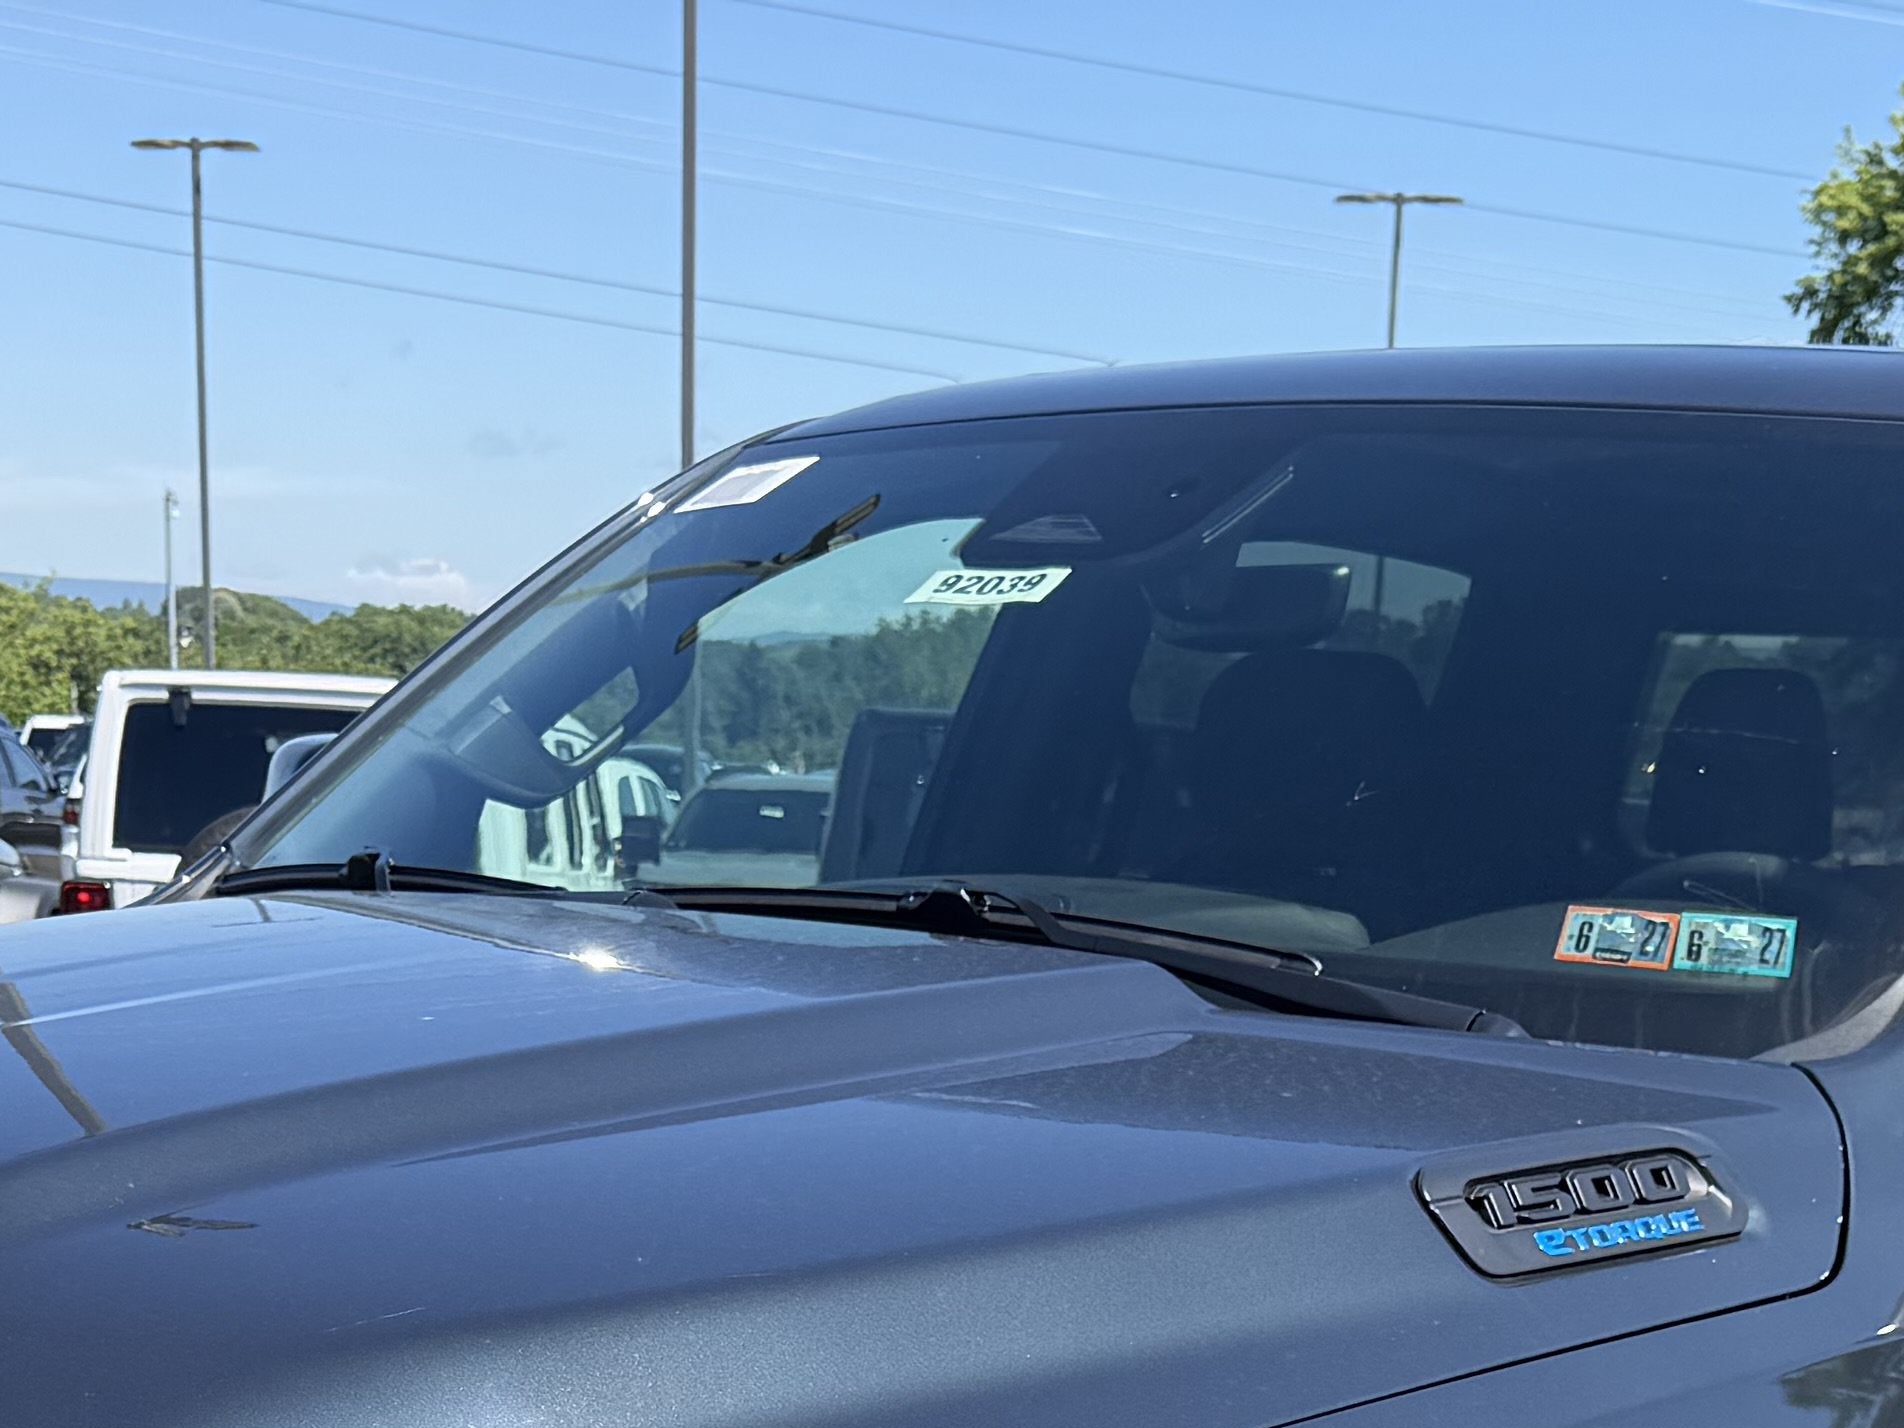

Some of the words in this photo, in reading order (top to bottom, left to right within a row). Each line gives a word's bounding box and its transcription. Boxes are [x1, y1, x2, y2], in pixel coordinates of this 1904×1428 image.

[932, 573, 1048, 596] 92039
[1574, 920, 1594, 953] 6
[1638, 919, 1671, 960] 27
[1686, 929, 1704, 962] 6
[1759, 925, 1788, 967] 27
[1468, 1153, 1691, 1230] 1500
